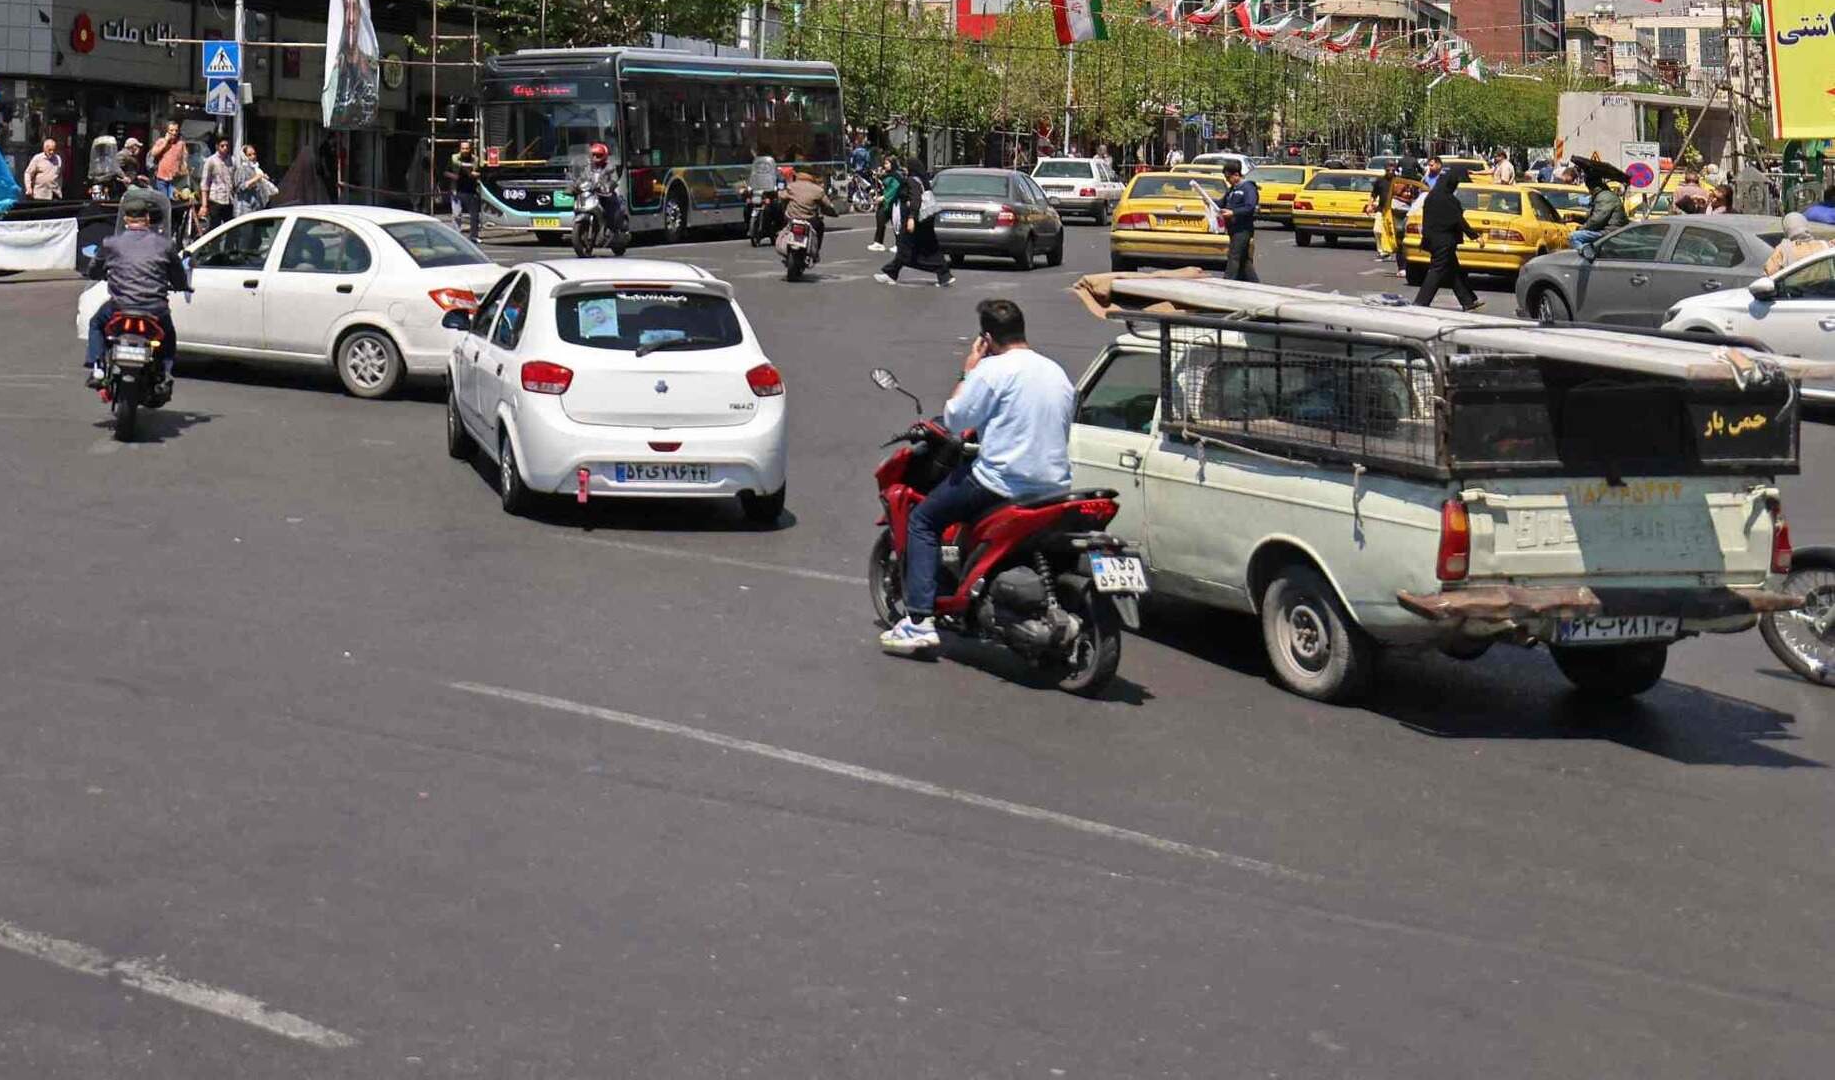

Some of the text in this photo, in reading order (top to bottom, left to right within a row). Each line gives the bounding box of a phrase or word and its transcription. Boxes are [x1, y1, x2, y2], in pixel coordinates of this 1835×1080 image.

[102, 17, 179, 57] بانک ملت
[1704, 410, 1724, 437] بار
